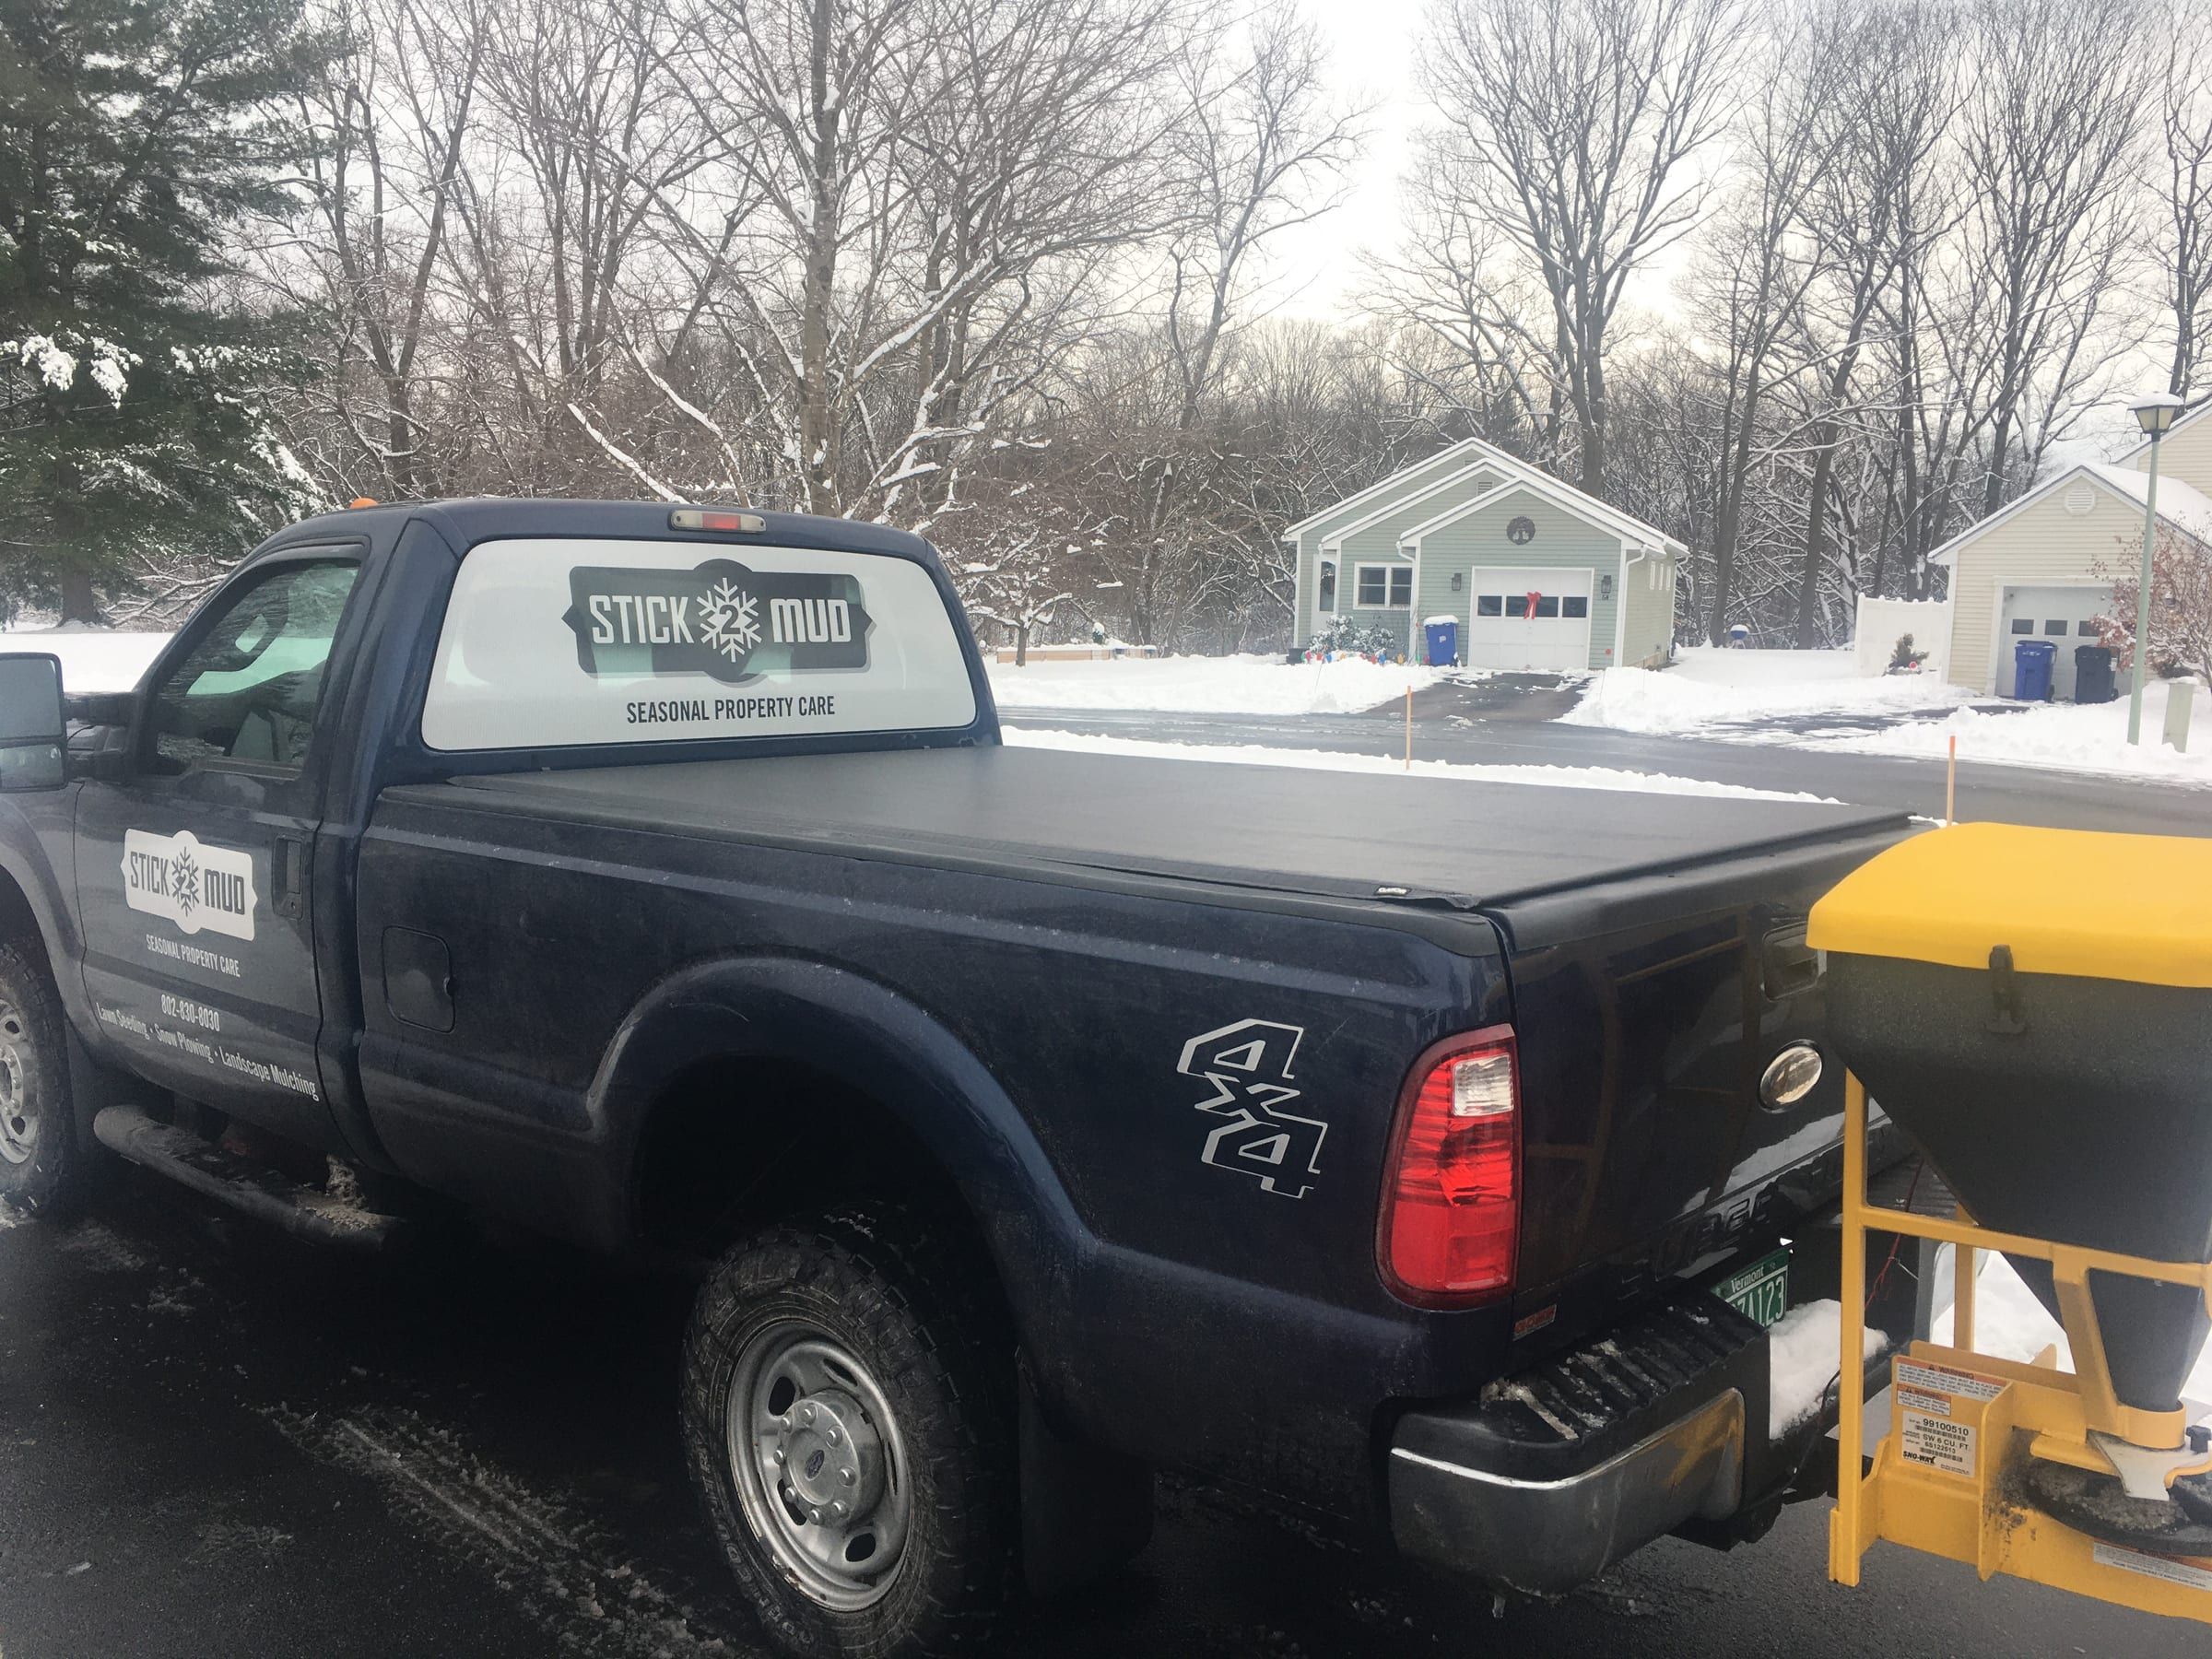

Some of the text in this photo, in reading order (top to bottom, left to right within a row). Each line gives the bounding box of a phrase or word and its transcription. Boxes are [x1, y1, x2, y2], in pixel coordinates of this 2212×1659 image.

[589, 594, 852, 644] STICK 2 MUD
[627, 696, 835, 724] SEASONAL PROPERTY CARE
[130, 852, 245, 915] STICK 2 MUD
[147, 934, 241, 978] SEASONAL PROPERTY CARE
[161, 994, 220, 1032] 802-830-8030
[96, 1002, 320, 1101] Lawn Seeding Snow Plowing Landscape Mulching
[1731, 1266, 1764, 1293] Vermont
[1923, 1418, 1969, 1436] 99100510
